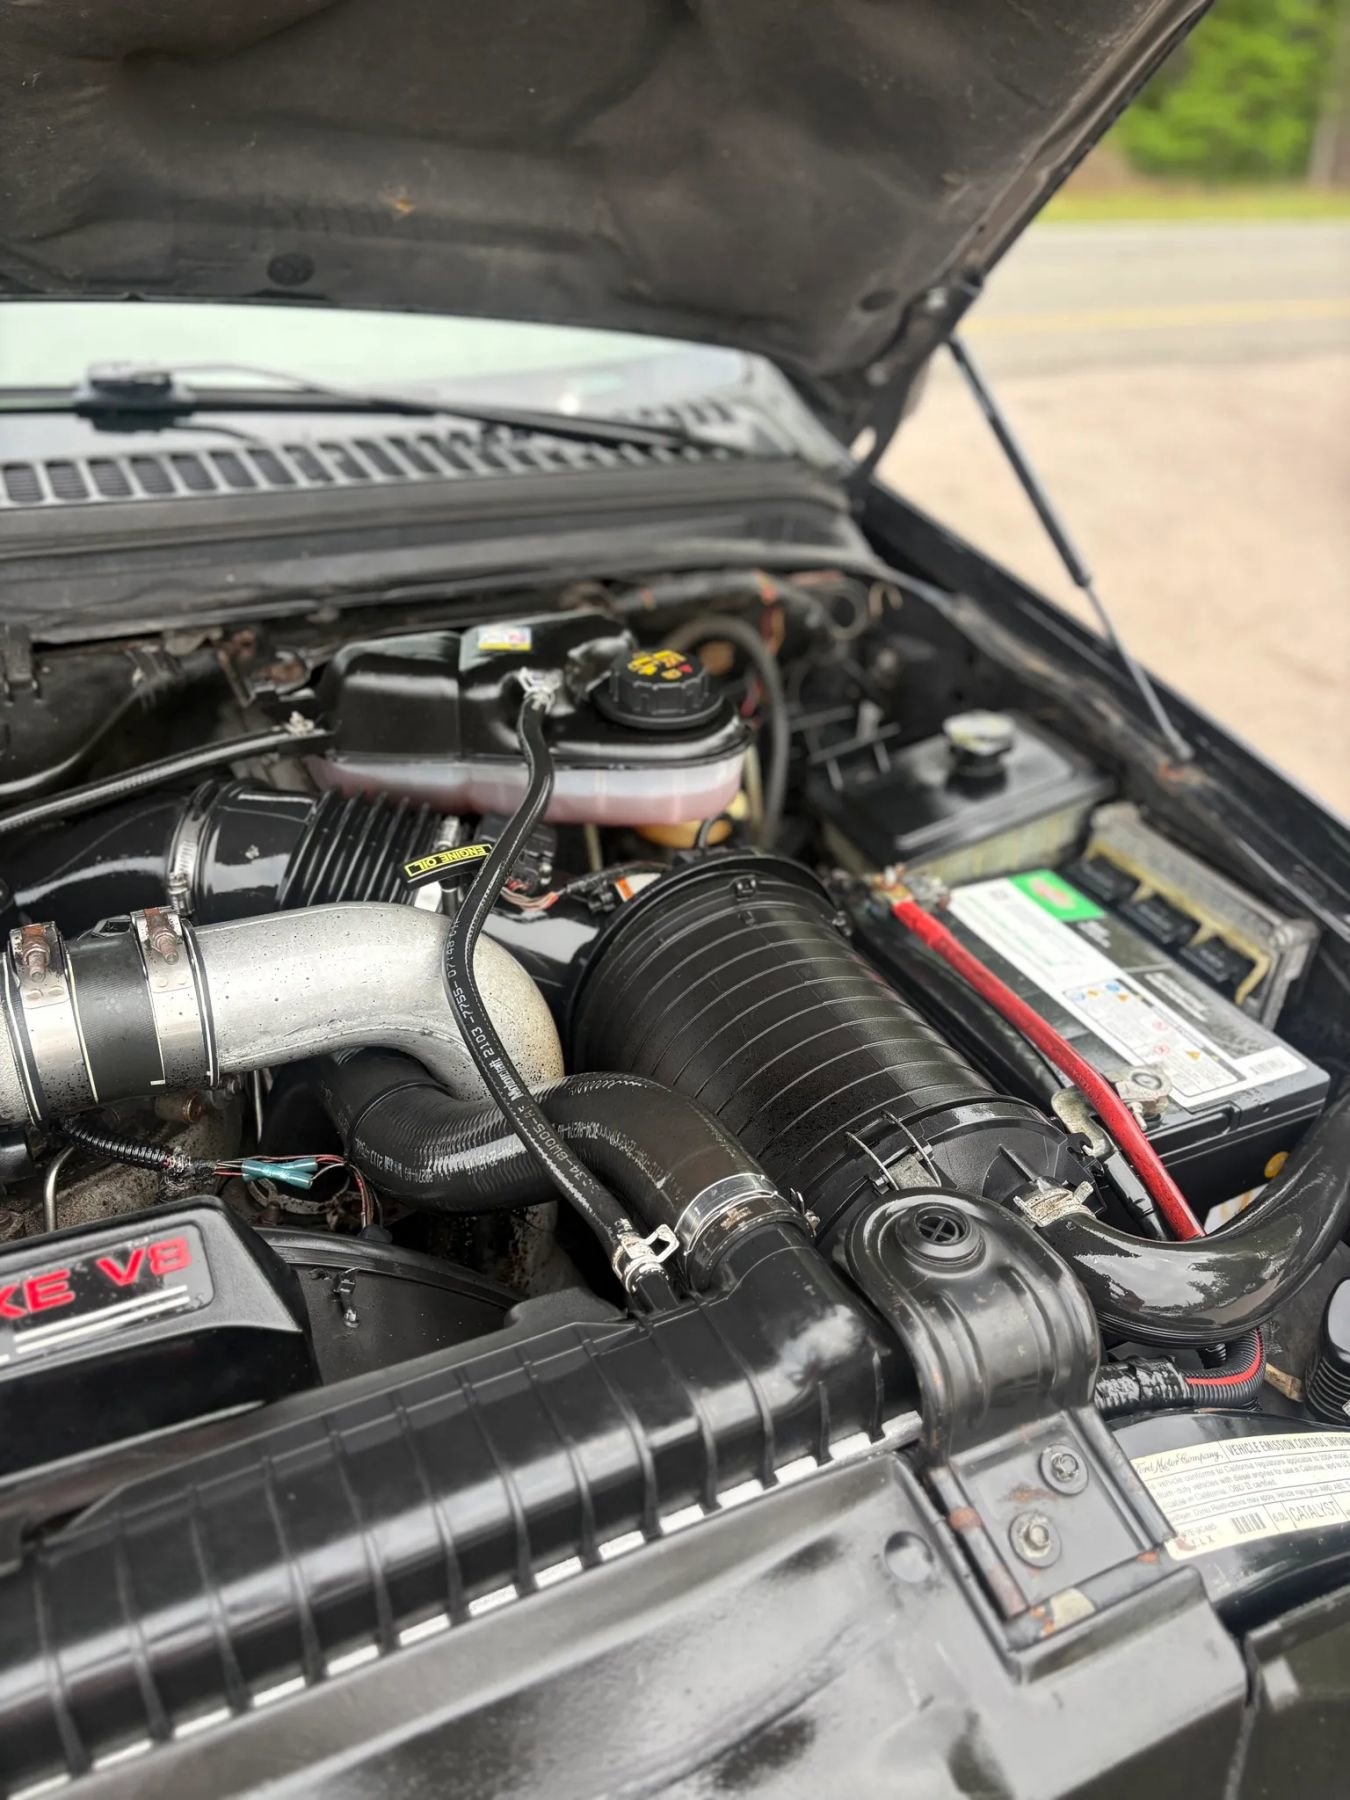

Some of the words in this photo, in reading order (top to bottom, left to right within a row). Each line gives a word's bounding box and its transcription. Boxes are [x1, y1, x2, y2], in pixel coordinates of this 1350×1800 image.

[414, 858, 437, 871] OIL
[439, 846, 486, 864] ENGINE
[470, 1026, 495, 1059] 2103
[489, 1057, 524, 1101] Motorcraft
[96, 1236, 192, 1287] V8
[1226, 1441, 1261, 1456] VEHICLE
[1259, 1439, 1295, 1452] EMISSION
[1293, 1436, 1328, 1448] CONTROL
[1152, 1456, 1179, 1473] Motor
[1288, 1500, 1341, 1522] CATALYST
